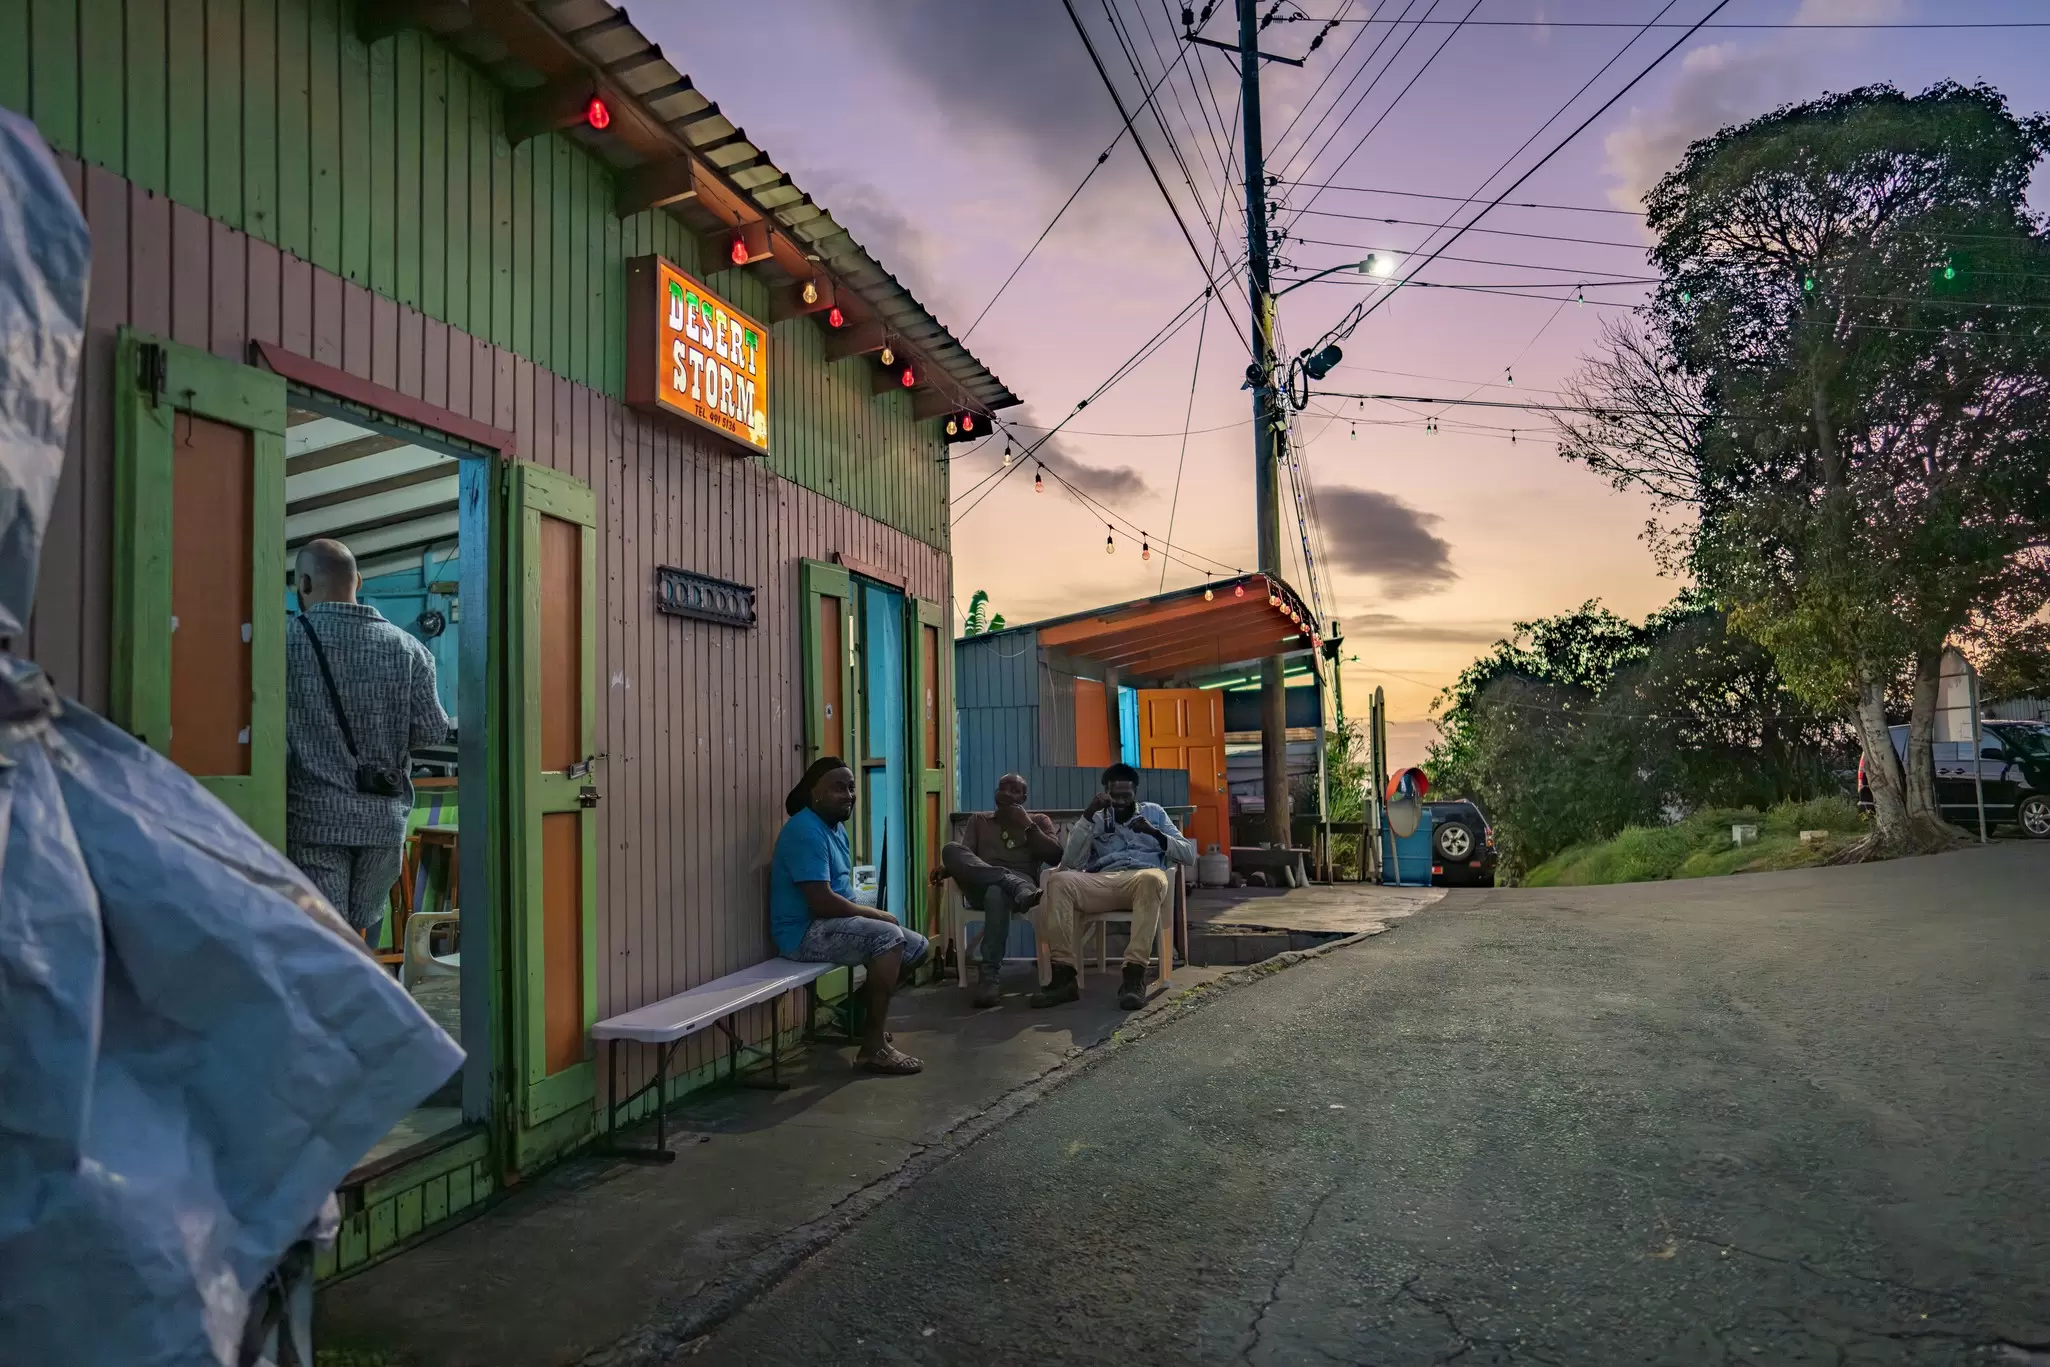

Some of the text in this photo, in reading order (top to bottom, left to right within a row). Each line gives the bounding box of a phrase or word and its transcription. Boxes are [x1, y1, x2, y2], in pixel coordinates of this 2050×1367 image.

[669, 280, 758, 375] DESERT
[673, 339, 755, 429] STORM
[695, 404, 707, 419] TEL.
